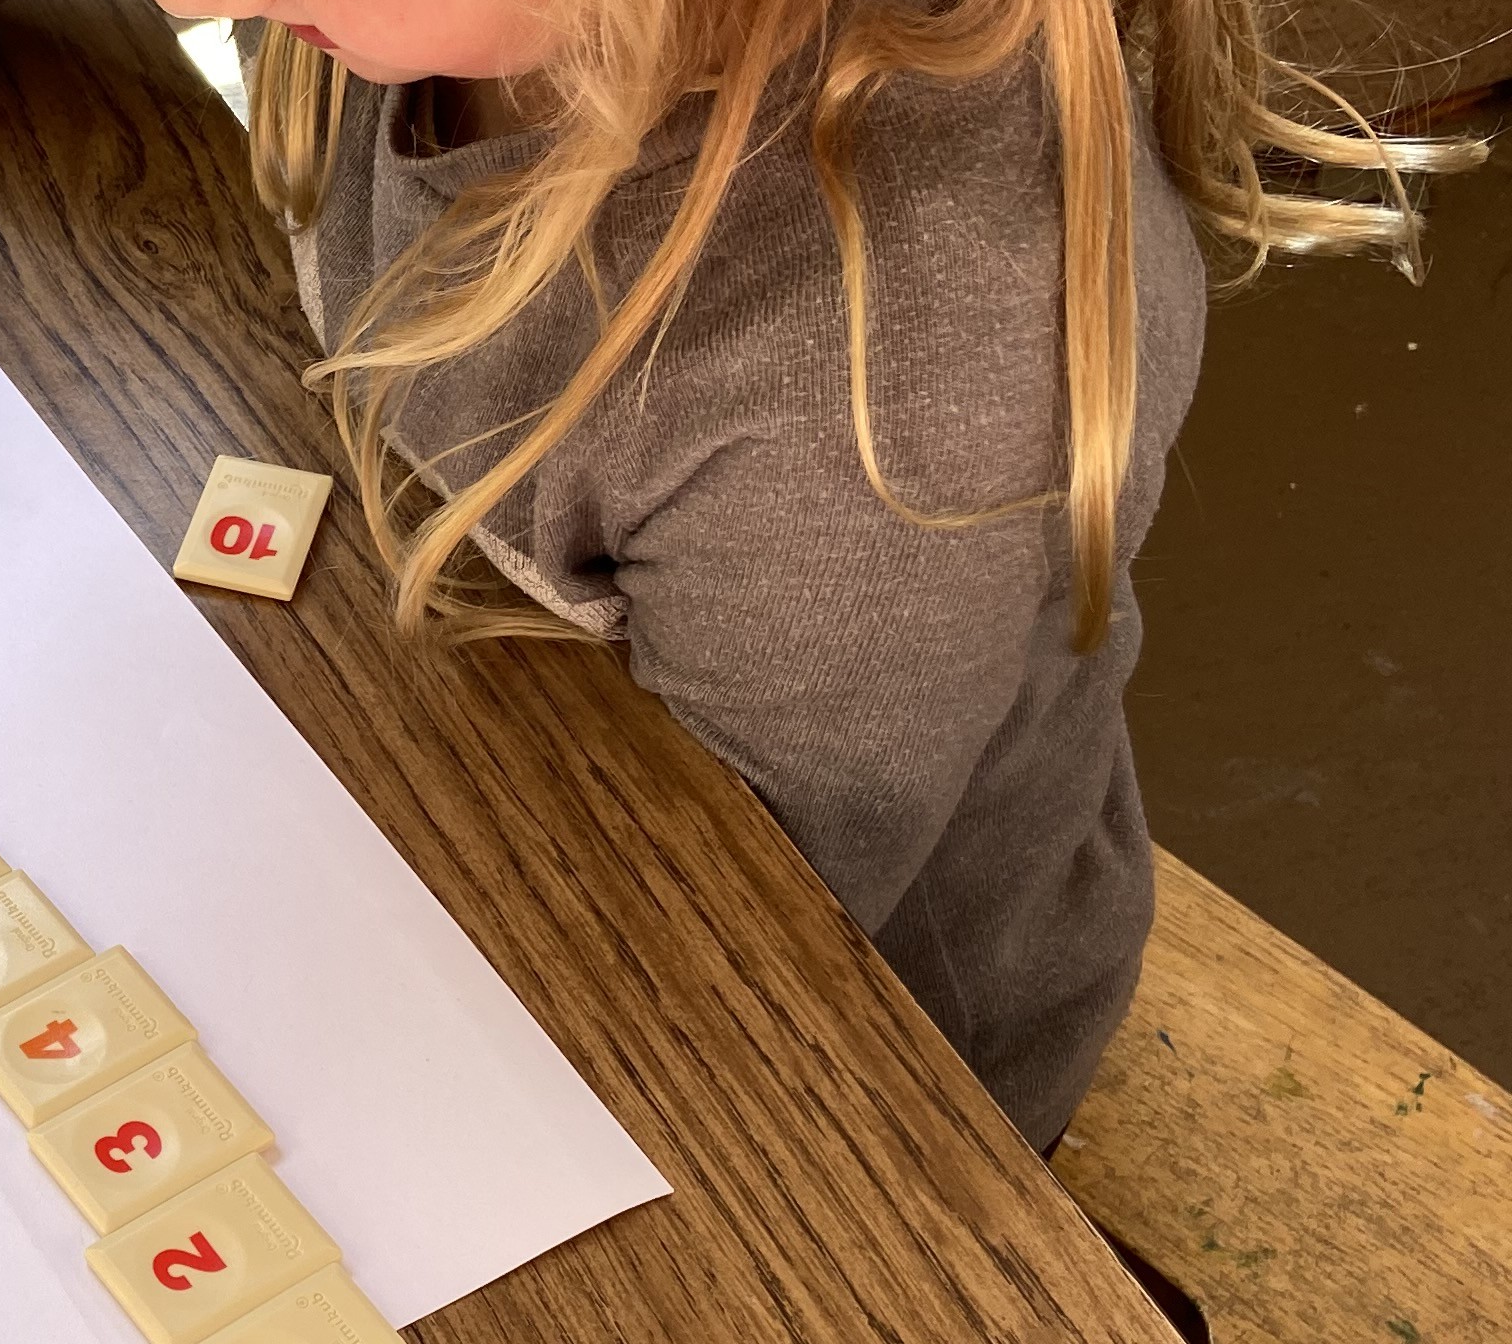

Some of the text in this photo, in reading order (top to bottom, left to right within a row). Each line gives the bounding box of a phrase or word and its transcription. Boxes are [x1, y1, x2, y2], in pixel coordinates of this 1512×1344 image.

[210, 515, 278, 561] 10
[18, 1018, 82, 1060] 4
[94, 1120, 163, 1173] 3
[152, 1231, 228, 1291] 2
